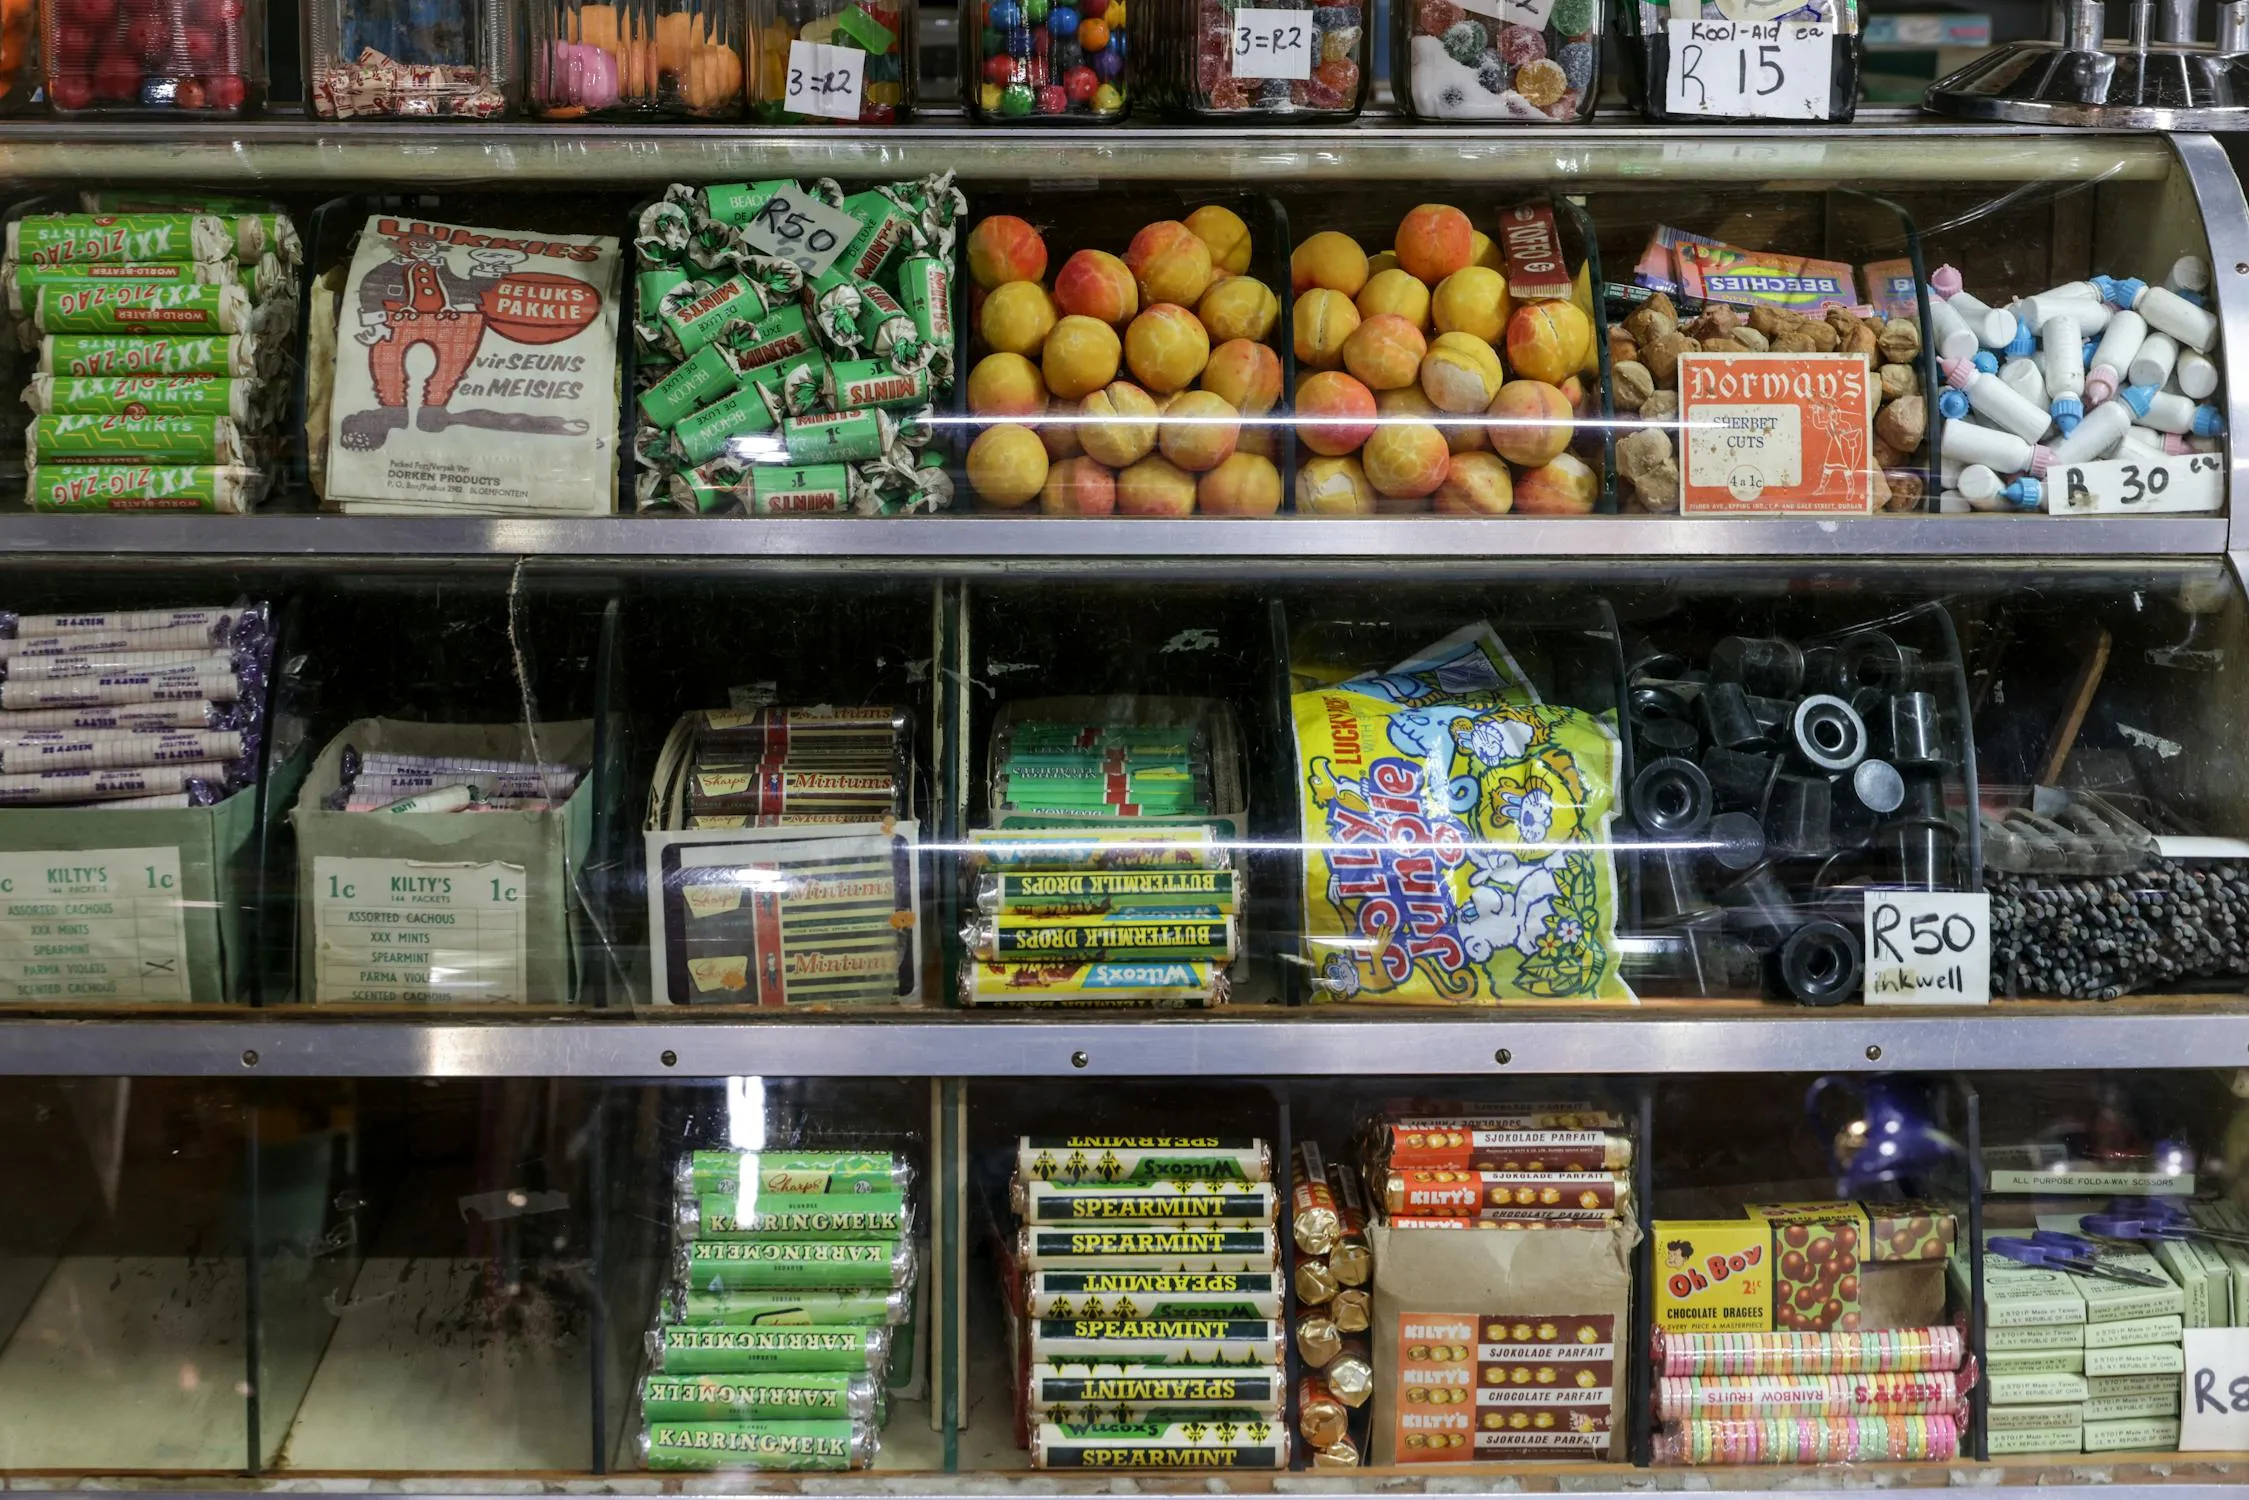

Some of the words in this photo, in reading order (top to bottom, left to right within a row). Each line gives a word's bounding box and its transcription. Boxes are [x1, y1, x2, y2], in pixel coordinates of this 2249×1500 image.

[1739, 45, 1785, 96] 15
[756, 198, 836, 252] R50
[1709, 277, 1834, 294] BEECHIES
[497, 298, 581, 320] PAKKIE
[678, 282, 740, 323] MINTS
[486, 378, 585, 400] MEISIES
[662, 374, 684, 395] LUXE
[667, 369, 710, 406] BEACON
[849, 375, 916, 405] MINTS
[137, 390, 205, 402] MINTS
[127, 422, 193, 432] MINTS
[697, 410, 720, 426] LUXE
[701, 410, 747, 441] BEACON
[1713, 416, 1778, 430] SHERBET
[1726, 436, 1764, 449] CUTS
[387, 470, 436, 481] DORKEN
[439, 473, 500, 487] PRODUCTS
[2120, 465, 2170, 505] 30
[768, 492, 835, 513] MINTS
[793, 772, 892, 790] Mintums
[47, 867, 108, 885] KILTY'S
[145, 866, 174, 889] 1c
[1022, 876, 1083, 895] DROPS
[1091, 874, 1216, 893] BUTTERMILK
[328, 875, 356, 899] 1c
[391, 876, 452, 894] KILTY'S
[490, 878, 519, 902] 1c
[411, 896, 451, 904] PACKETS
[7, 904, 58, 916] ASSORTED
[64, 903, 113, 915] CACHOUS
[348, 911, 400, 924] ASSORTED
[406, 913, 456, 925] CACHOUS
[31, 925, 52, 935] XXX
[57, 924, 90, 935] MINTS
[370, 932, 391, 943] XXX
[398, 933, 430, 944] MINTS
[1016, 928, 1078, 949] DROPS
[1084, 926, 1210, 948] BUTTERMILK
[1872, 904, 1975, 963] R50
[33, 944, 90, 956] SPEARMINT
[371, 952, 430, 964] SPEARMINT
[23, 965, 60, 976] PARMA
[66, 964, 108, 975] VIOLETS
[360, 972, 397, 983] PARMA
[68, 982, 117, 994] CACHOUS
[1874, 966, 1963, 994] inkwell
[352, 991, 397, 1001] SCENTED
[1484, 1132, 1546, 1143] SJOKOLADE
[1551, 1132, 1597, 1142] PARFAIT
[2013, 1177, 2029, 1185] ALL
[2033, 1177, 2073, 1186] PURPOSE
[2132, 1178, 2174, 1187] SCISSORS
[1410, 1187, 1476, 1206] KILTY'S
[1072, 1197, 1226, 1217] SPEARMINT
[696, 1244, 881, 1262] KARRINGMELK
[1072, 1234, 1225, 1254] SPEARMINT
[1668, 1267, 1708, 1298] Oh
[1706, 1245, 1763, 1282] Boy
[1083, 1275, 1237, 1292] SPEARMINT
[1667, 1307, 1717, 1320] CHOCOLATE
[1723, 1306, 1763, 1319] DRAGEES
[1074, 1320, 1229, 1338] SPEARMINT
[1404, 1322, 1472, 1341] KILTY'S
[670, 1332, 856, 1350] KARRINGMELK
[1489, 1347, 1552, 1358] SJOKOLADE
[1557, 1347, 1605, 1358] PARFAIT
[1403, 1367, 1471, 1385] KILTY'S
[651, 1384, 838, 1407] KARRINGMELK
[1081, 1379, 1236, 1398] SPEARMINT
[1488, 1391, 1552, 1402] CHOCOLATE
[1556, 1391, 1604, 1402] PARFAIT
[1708, 1391, 1754, 1403] FRUITS
[1761, 1389, 1824, 1402] RAINBOW
[1402, 1411, 1469, 1429] KILTY'S
[659, 1429, 846, 1455] KARRINGMELK
[1486, 1434, 1550, 1445] SJOKOLADE
[1554, 1434, 1601, 1446] PARFAIT
[1082, 1449, 1237, 1467] SPEARMINT
